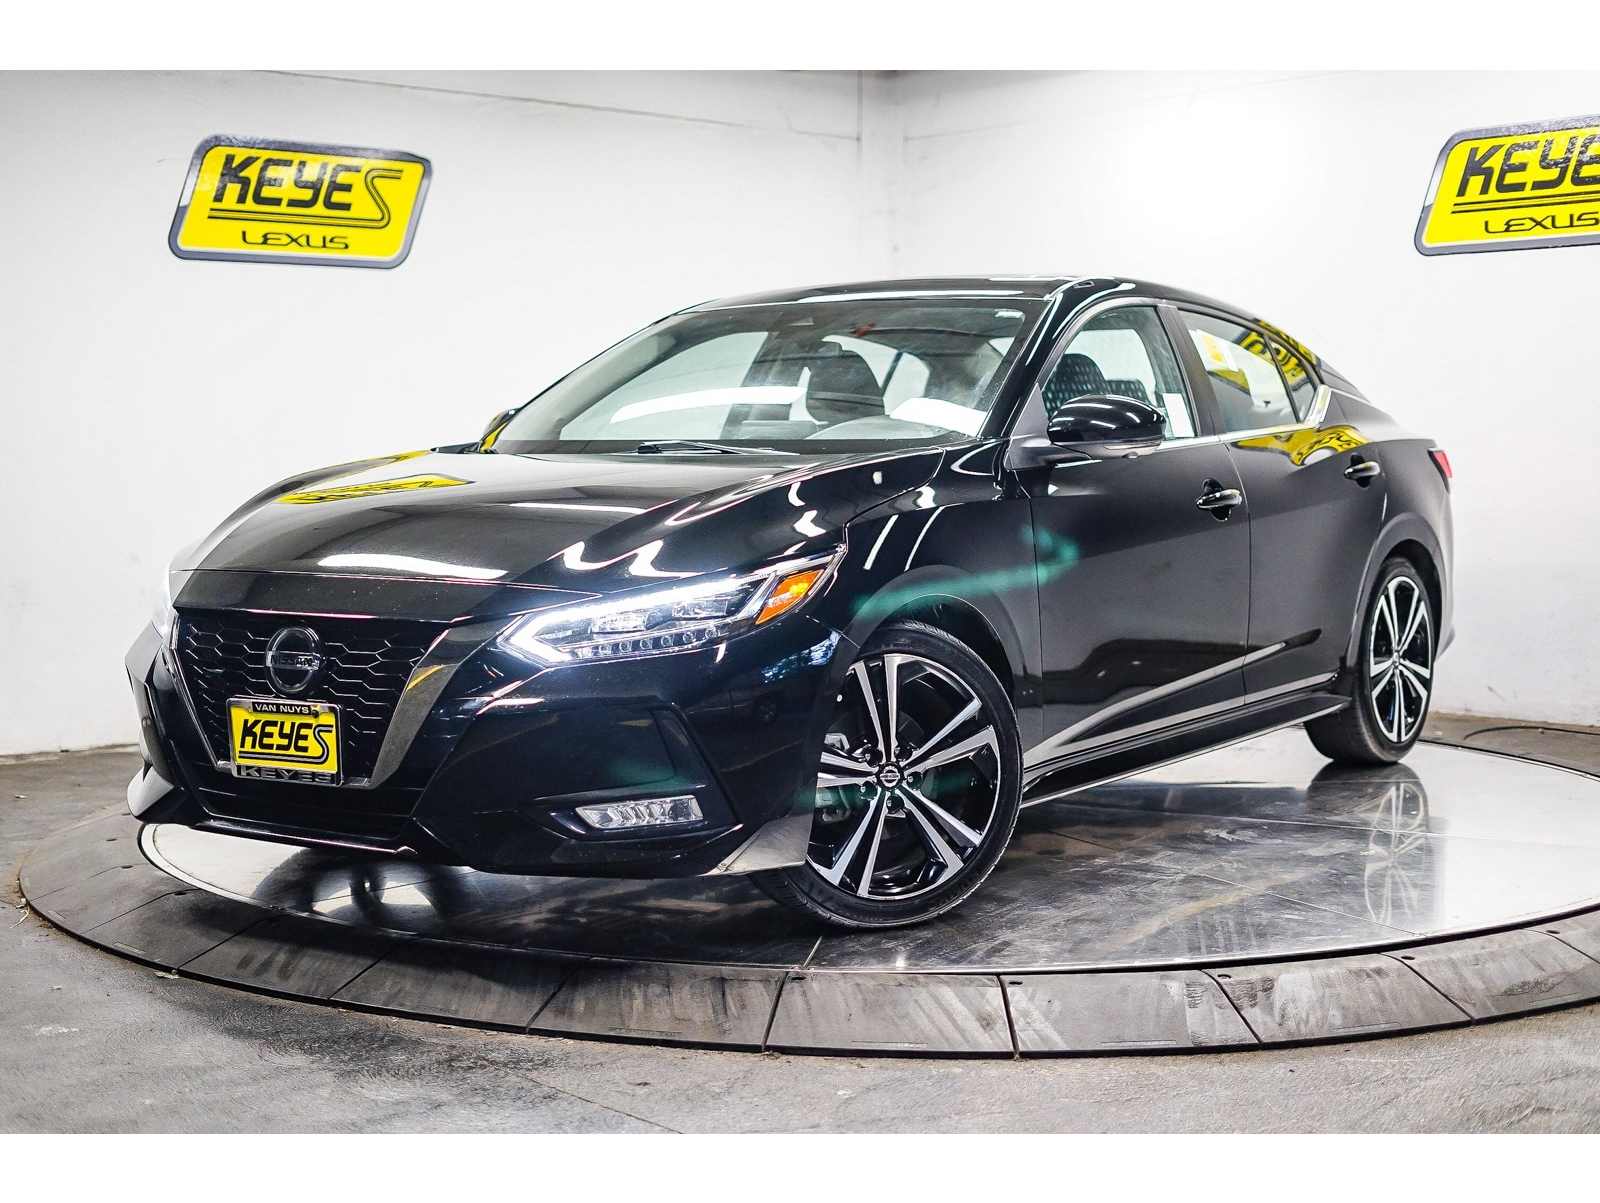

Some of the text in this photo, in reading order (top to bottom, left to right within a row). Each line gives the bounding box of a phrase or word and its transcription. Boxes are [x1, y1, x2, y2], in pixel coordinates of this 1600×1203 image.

[209, 153, 404, 229] KEYES
[1484, 211, 1600, 234] LEXUS
[241, 230, 349, 250] LEXUS
[254, 703, 310, 715] VAN NUYS
[239, 718, 334, 764] KEYES
